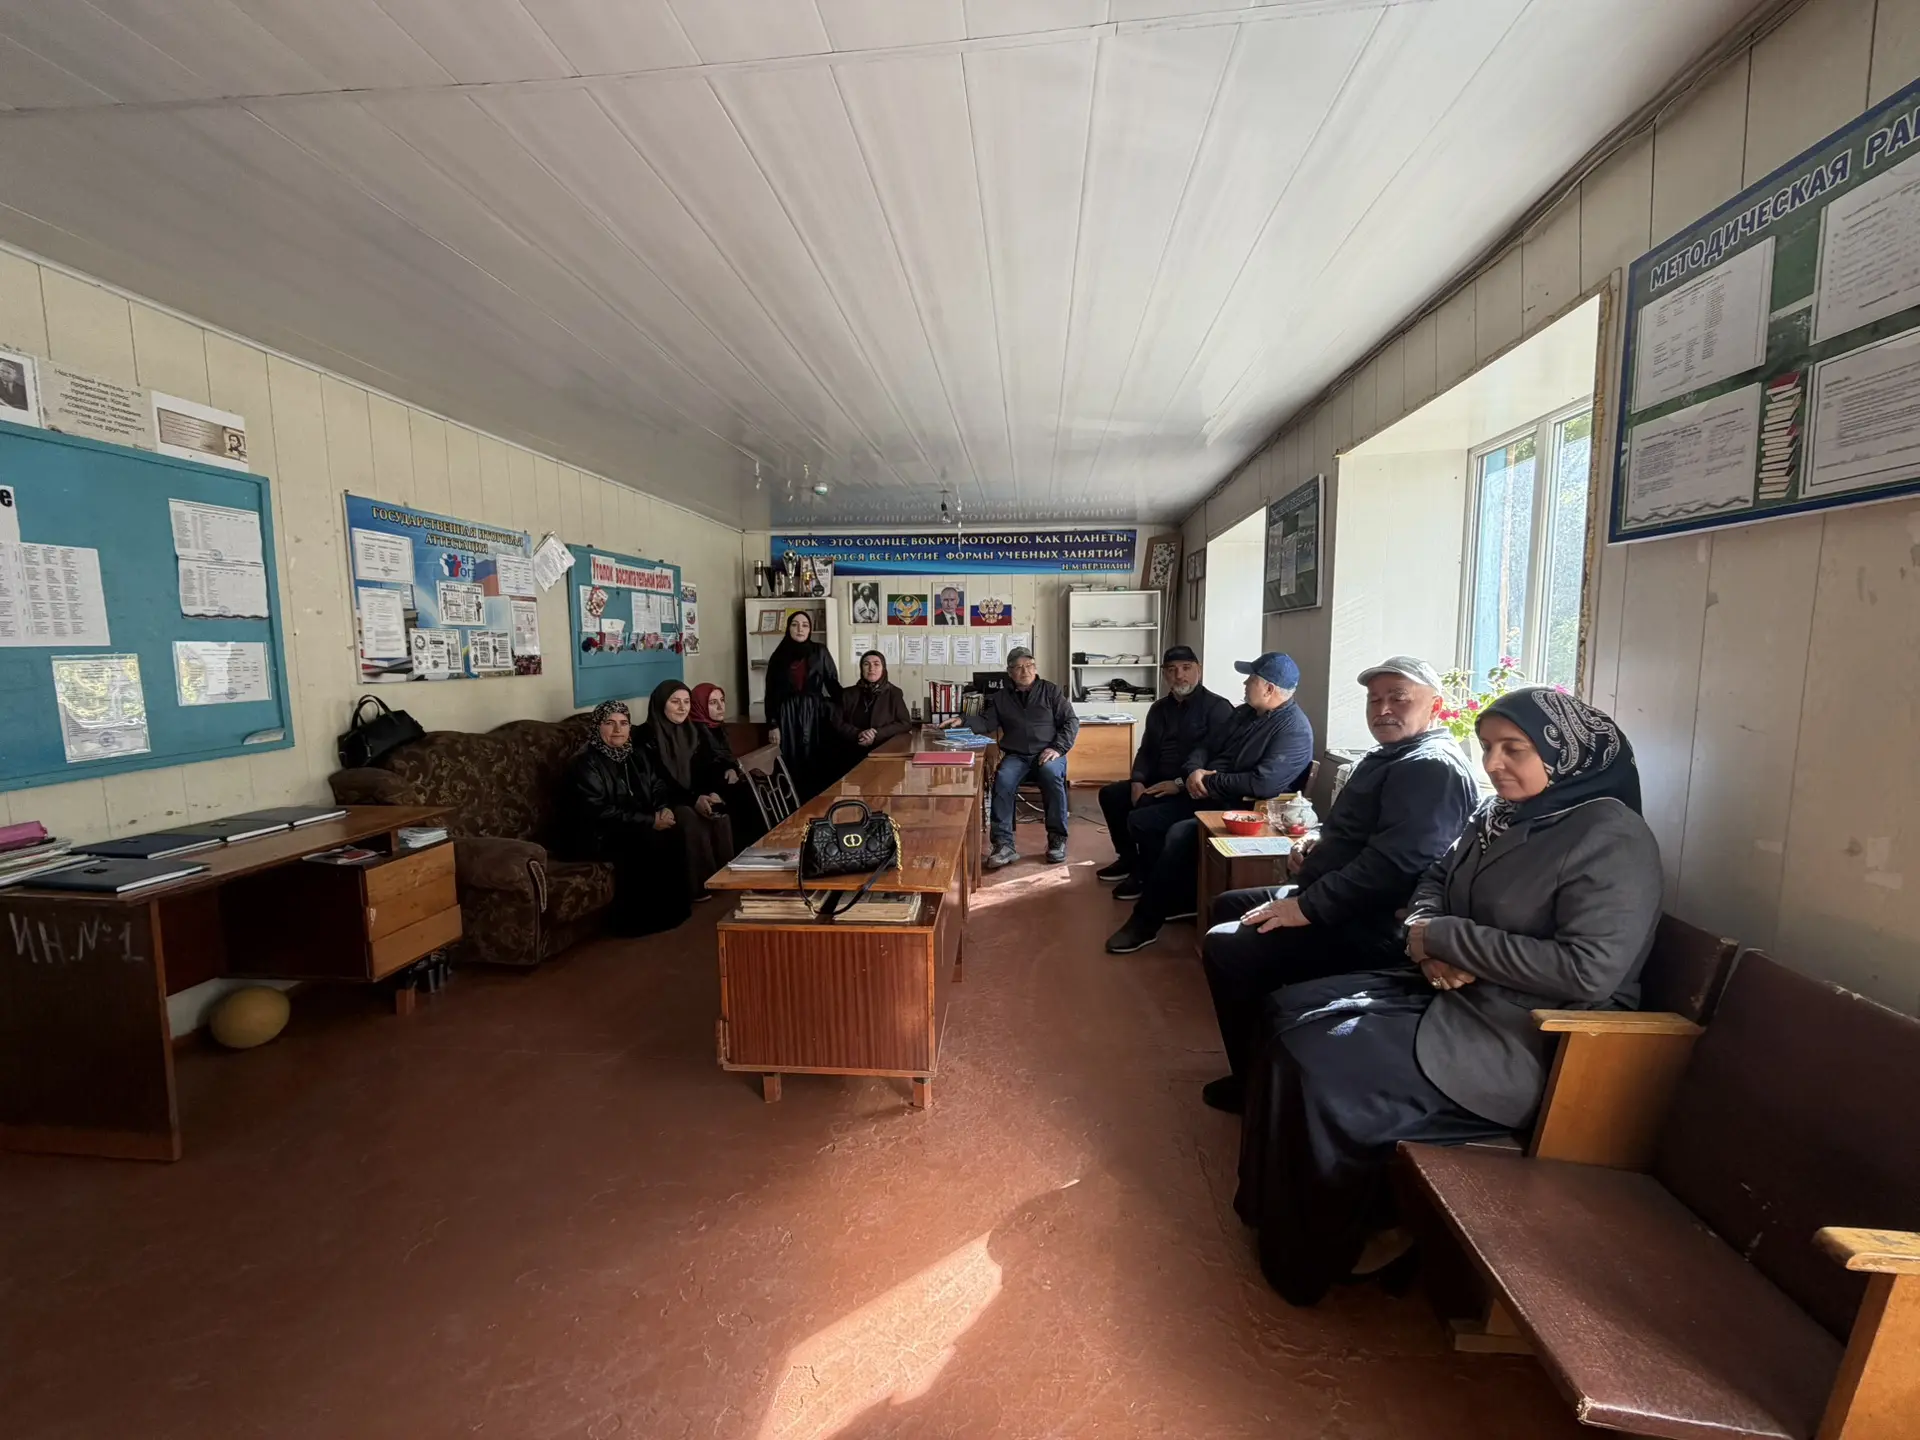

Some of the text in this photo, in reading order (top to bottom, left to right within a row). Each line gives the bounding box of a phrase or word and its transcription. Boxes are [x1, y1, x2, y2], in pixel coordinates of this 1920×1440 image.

[1650, 149, 1852, 292] МЕТОДИЧЕСКАЯ
[372, 505, 525, 547] ГОСУДАРСТВЕННАЯ ИТОГОВАЯ
[425, 533, 489, 555] АТТЕСТАЦИЯ
[829, 538, 853, 547] ЭТО
[856, 537, 909, 547] СОЛНЦЕ,
[911, 536, 957, 546] ВОКРУГ
[1035, 534, 1061, 544] КАК
[461, 554, 476, 566] ЕГЭ
[796, 547, 1128, 562] РЮТСЯ ВСЕ ДРУГИЕ ФОРМЫ УЧЕБНЫХ ЗАНЯТИЙ"
